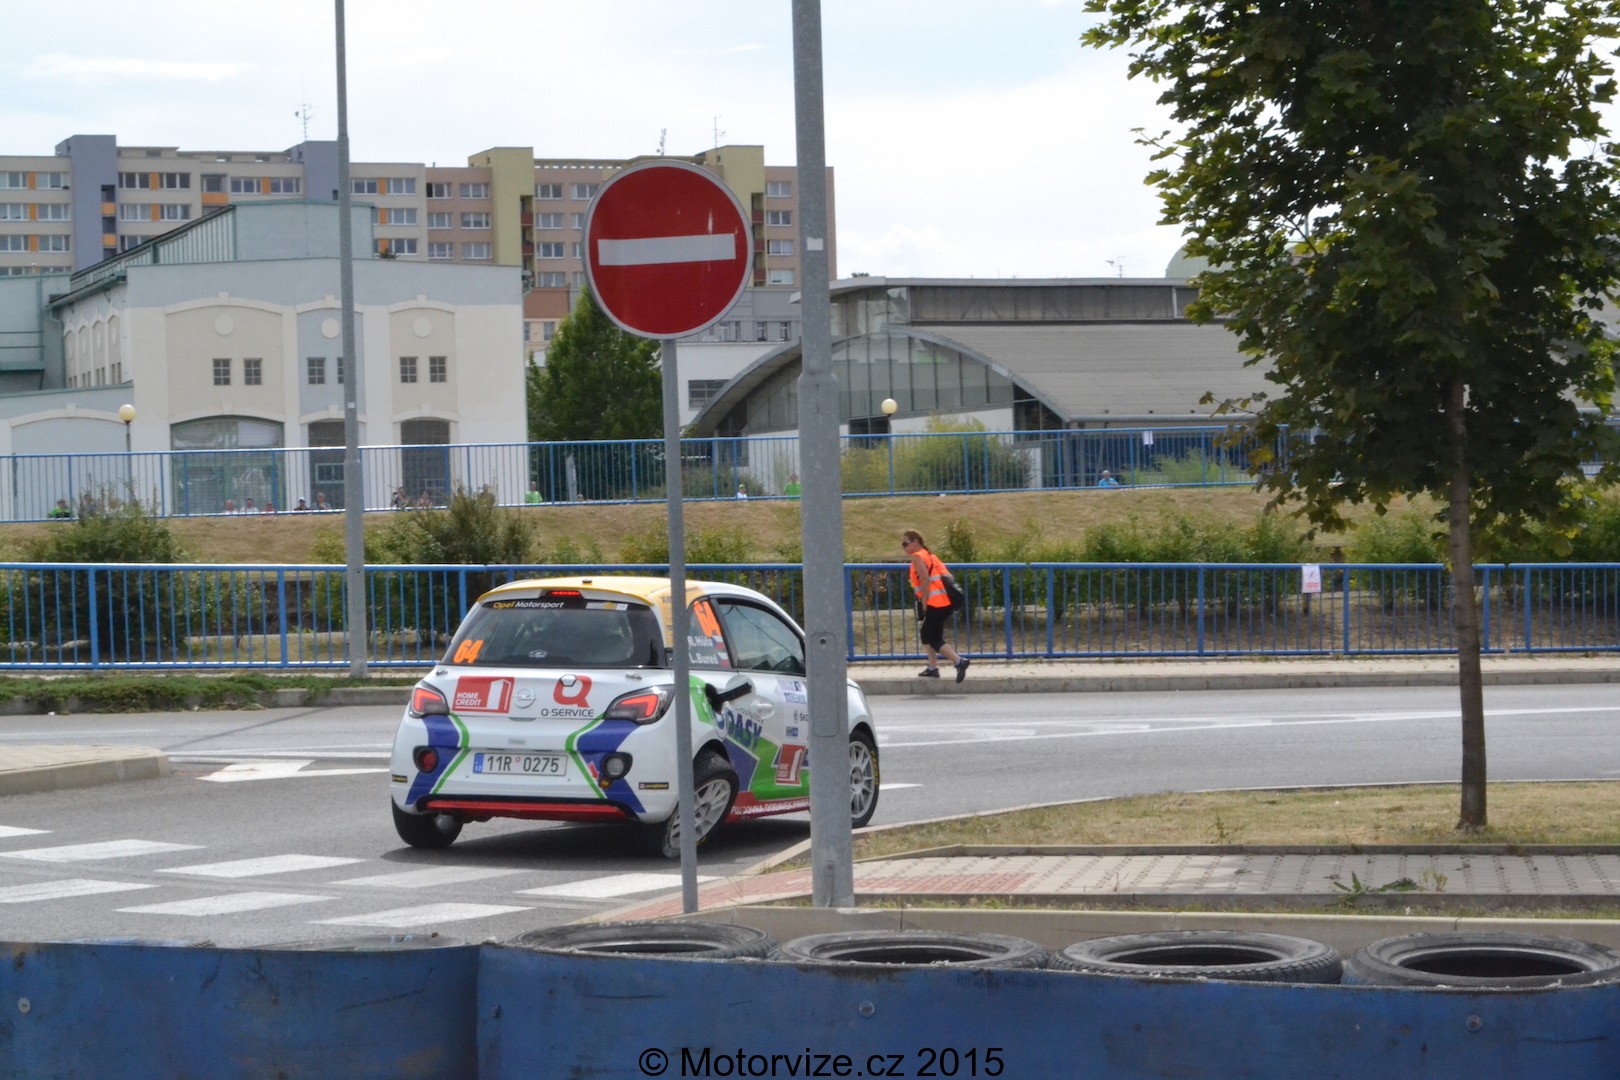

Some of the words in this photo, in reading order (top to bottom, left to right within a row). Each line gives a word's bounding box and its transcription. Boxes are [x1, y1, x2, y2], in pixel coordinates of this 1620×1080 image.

[493, 601, 515, 609] Opel
[515, 601, 564, 609] Motorsport
[453, 639, 485, 664] 64
[456, 692, 479, 700] HOME
[487, 756, 512, 771] 11R
[523, 757, 559, 773] 0275
